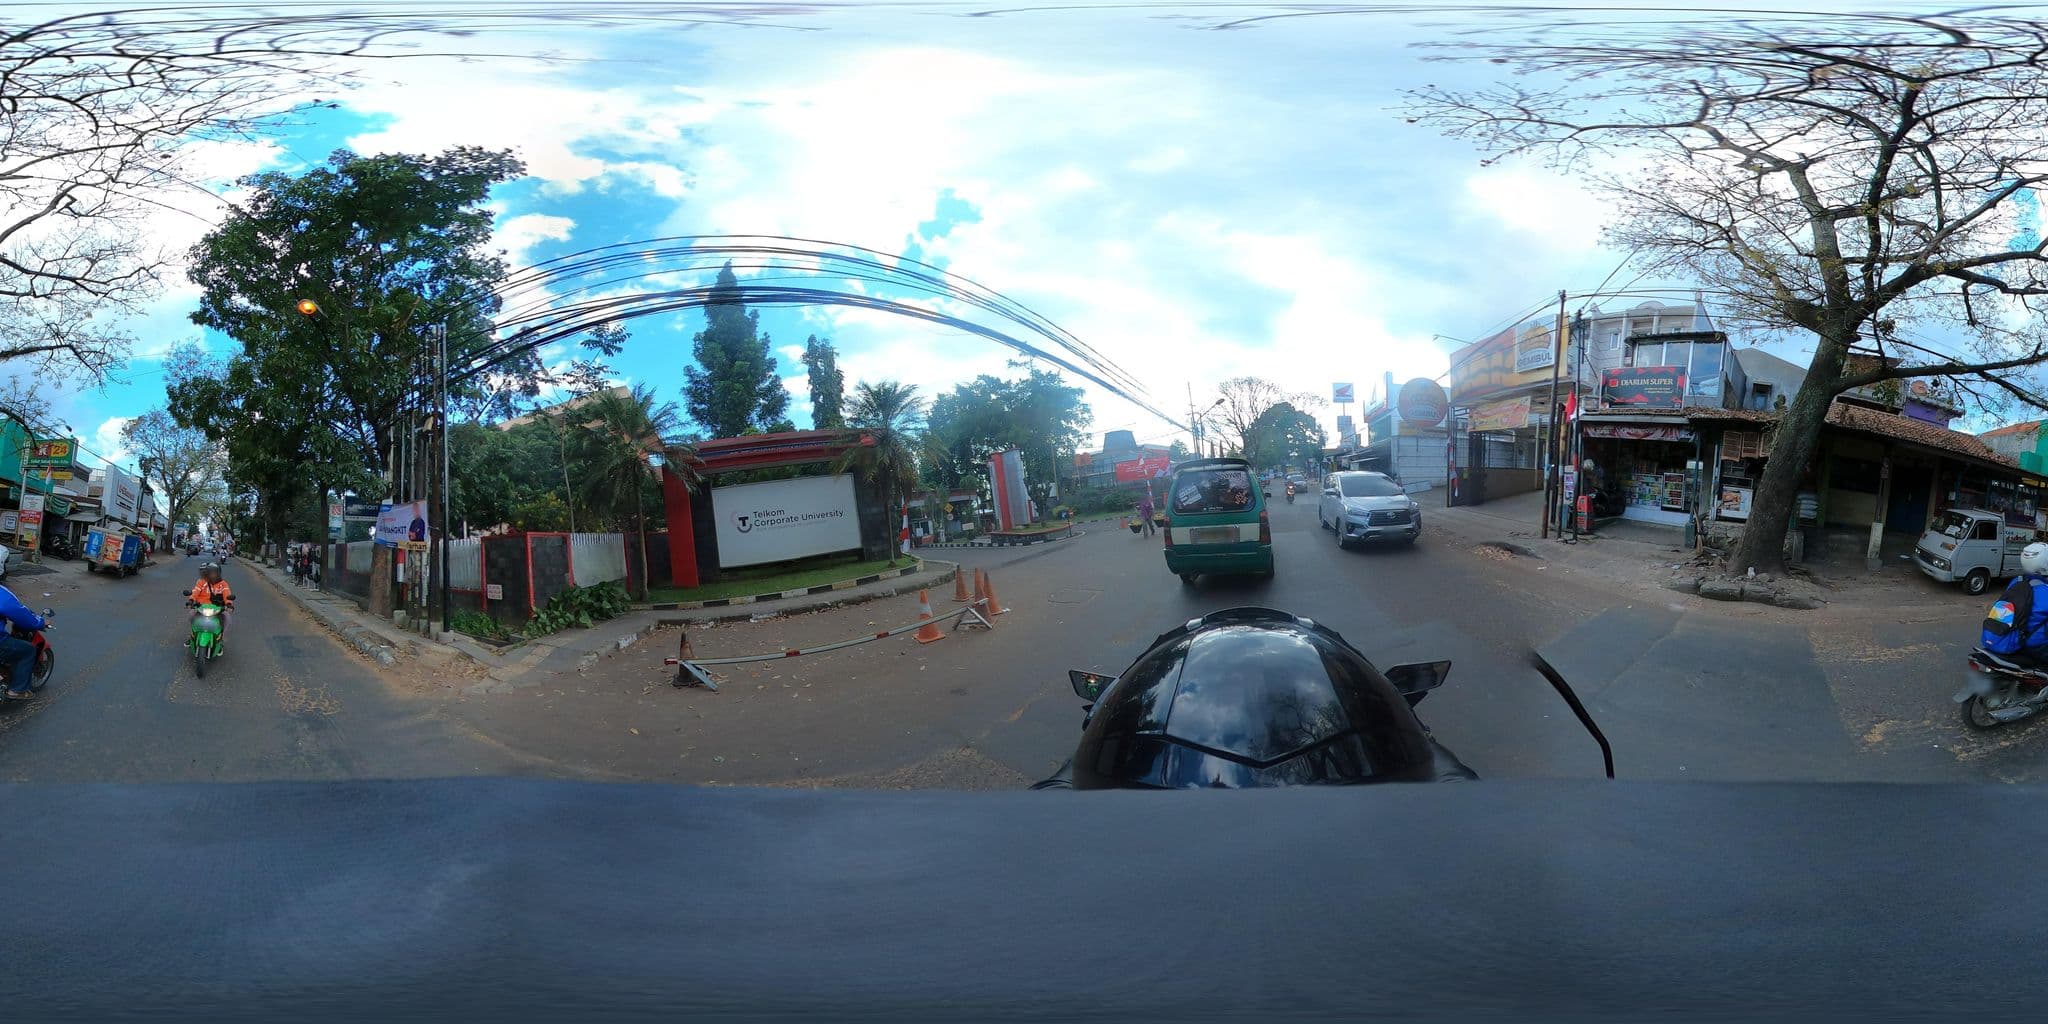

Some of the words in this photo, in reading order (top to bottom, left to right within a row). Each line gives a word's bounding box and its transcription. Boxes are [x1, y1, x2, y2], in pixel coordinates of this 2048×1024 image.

[753, 509, 785, 519] Telkom
[753, 516, 799, 527] Corporate
[801, 509, 844, 521] University
